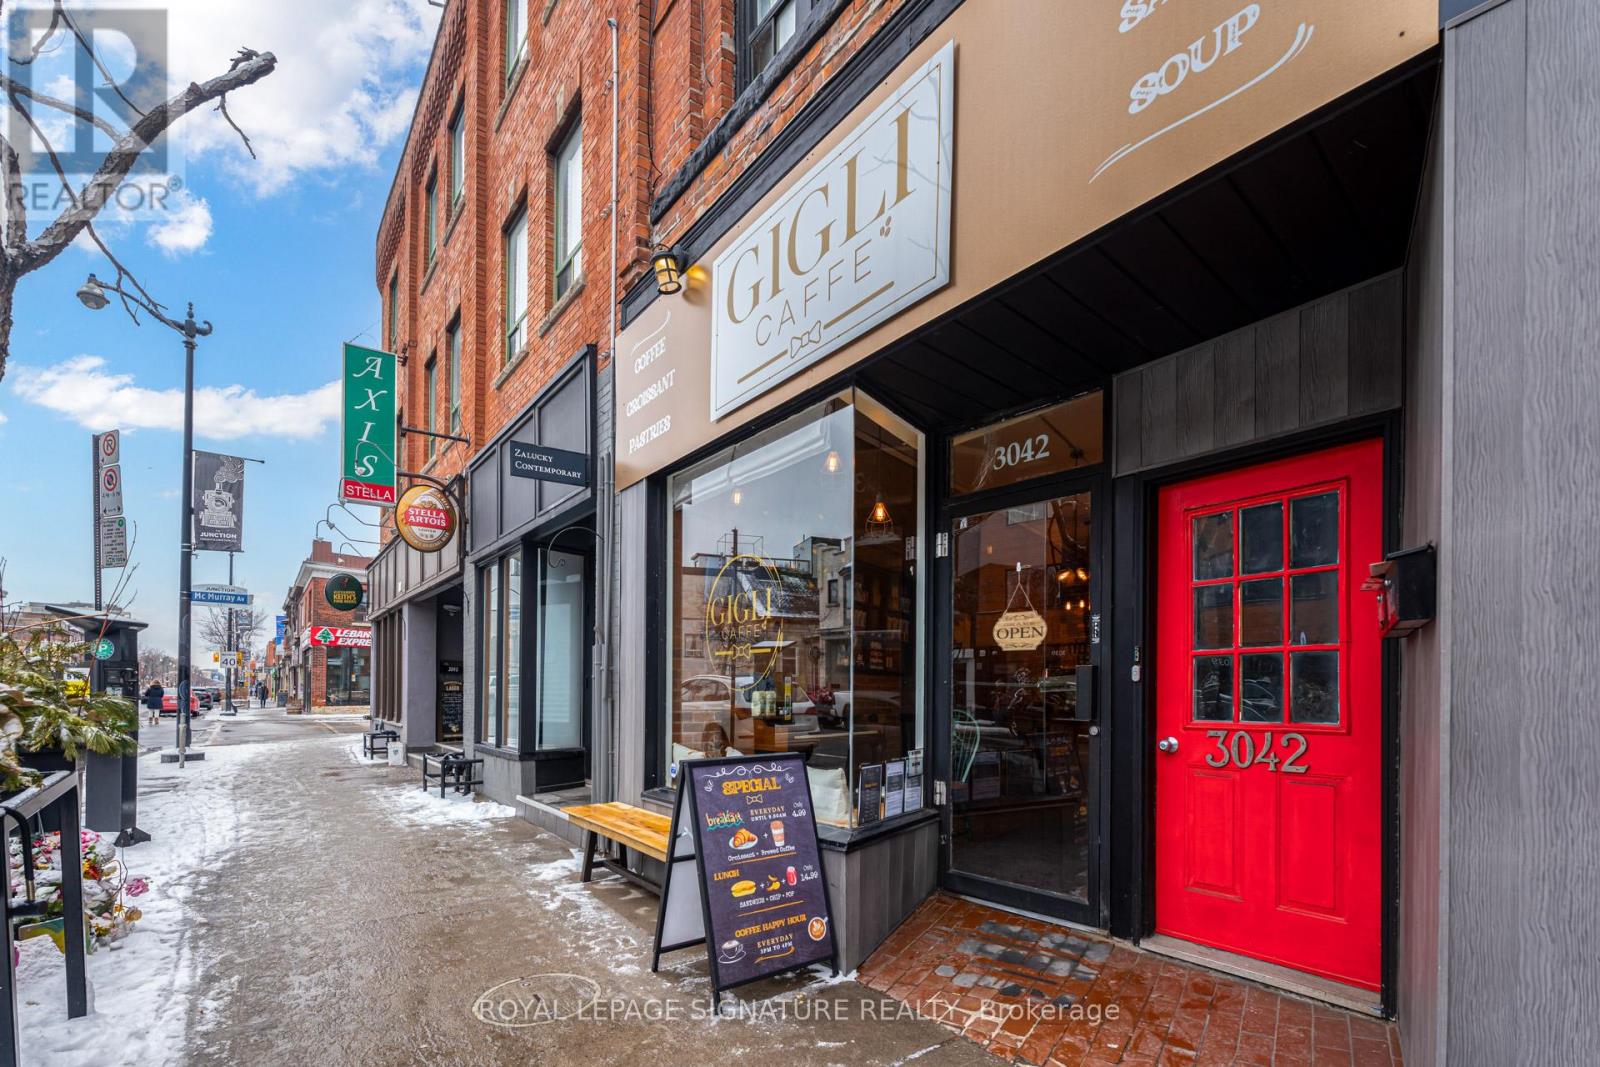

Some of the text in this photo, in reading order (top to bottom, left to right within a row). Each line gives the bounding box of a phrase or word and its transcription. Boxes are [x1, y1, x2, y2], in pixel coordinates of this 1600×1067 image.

[1128, 4, 1260, 114] SOUP
[726, 100, 917, 325] GIGLI
[755, 239, 872, 346] CAFFE
[634, 337, 666, 374] COFFEE
[626, 369, 676, 417] CROISSANT
[352, 356, 388, 478] AXIS
[628, 415, 671, 453] PASTRIES
[993, 434, 1050, 470] 3042
[345, 484, 392, 501] STELLA
[408, 507, 446, 519] STELLA
[408, 515, 447, 527] ARTOIS
[200, 531, 237, 539] JUNCTION
[207, 593, 236, 603] Murray
[711, 585, 773, 626] GIGLI
[721, 623, 761, 641] CAFFE
[996, 625, 1044, 640] OPEN
[222, 658, 236, 667] 40
[1205, 730, 1309, 773] 3042
[722, 776, 781, 796] SPECIAL
[705, 810, 743, 827] breakfast
[750, 805, 785, 816] EVERYDAY
[792, 808, 807, 818] 4.99
[779, 845, 796, 853] Coffee
[713, 868, 740, 881] LUNCH
[800, 870, 819, 882] 14.99
[739, 897, 766, 908] SANDWICH
[735, 913, 807, 938] COFFEE HAPPY HOUR
[757, 933, 794, 949] EVERYDAY
